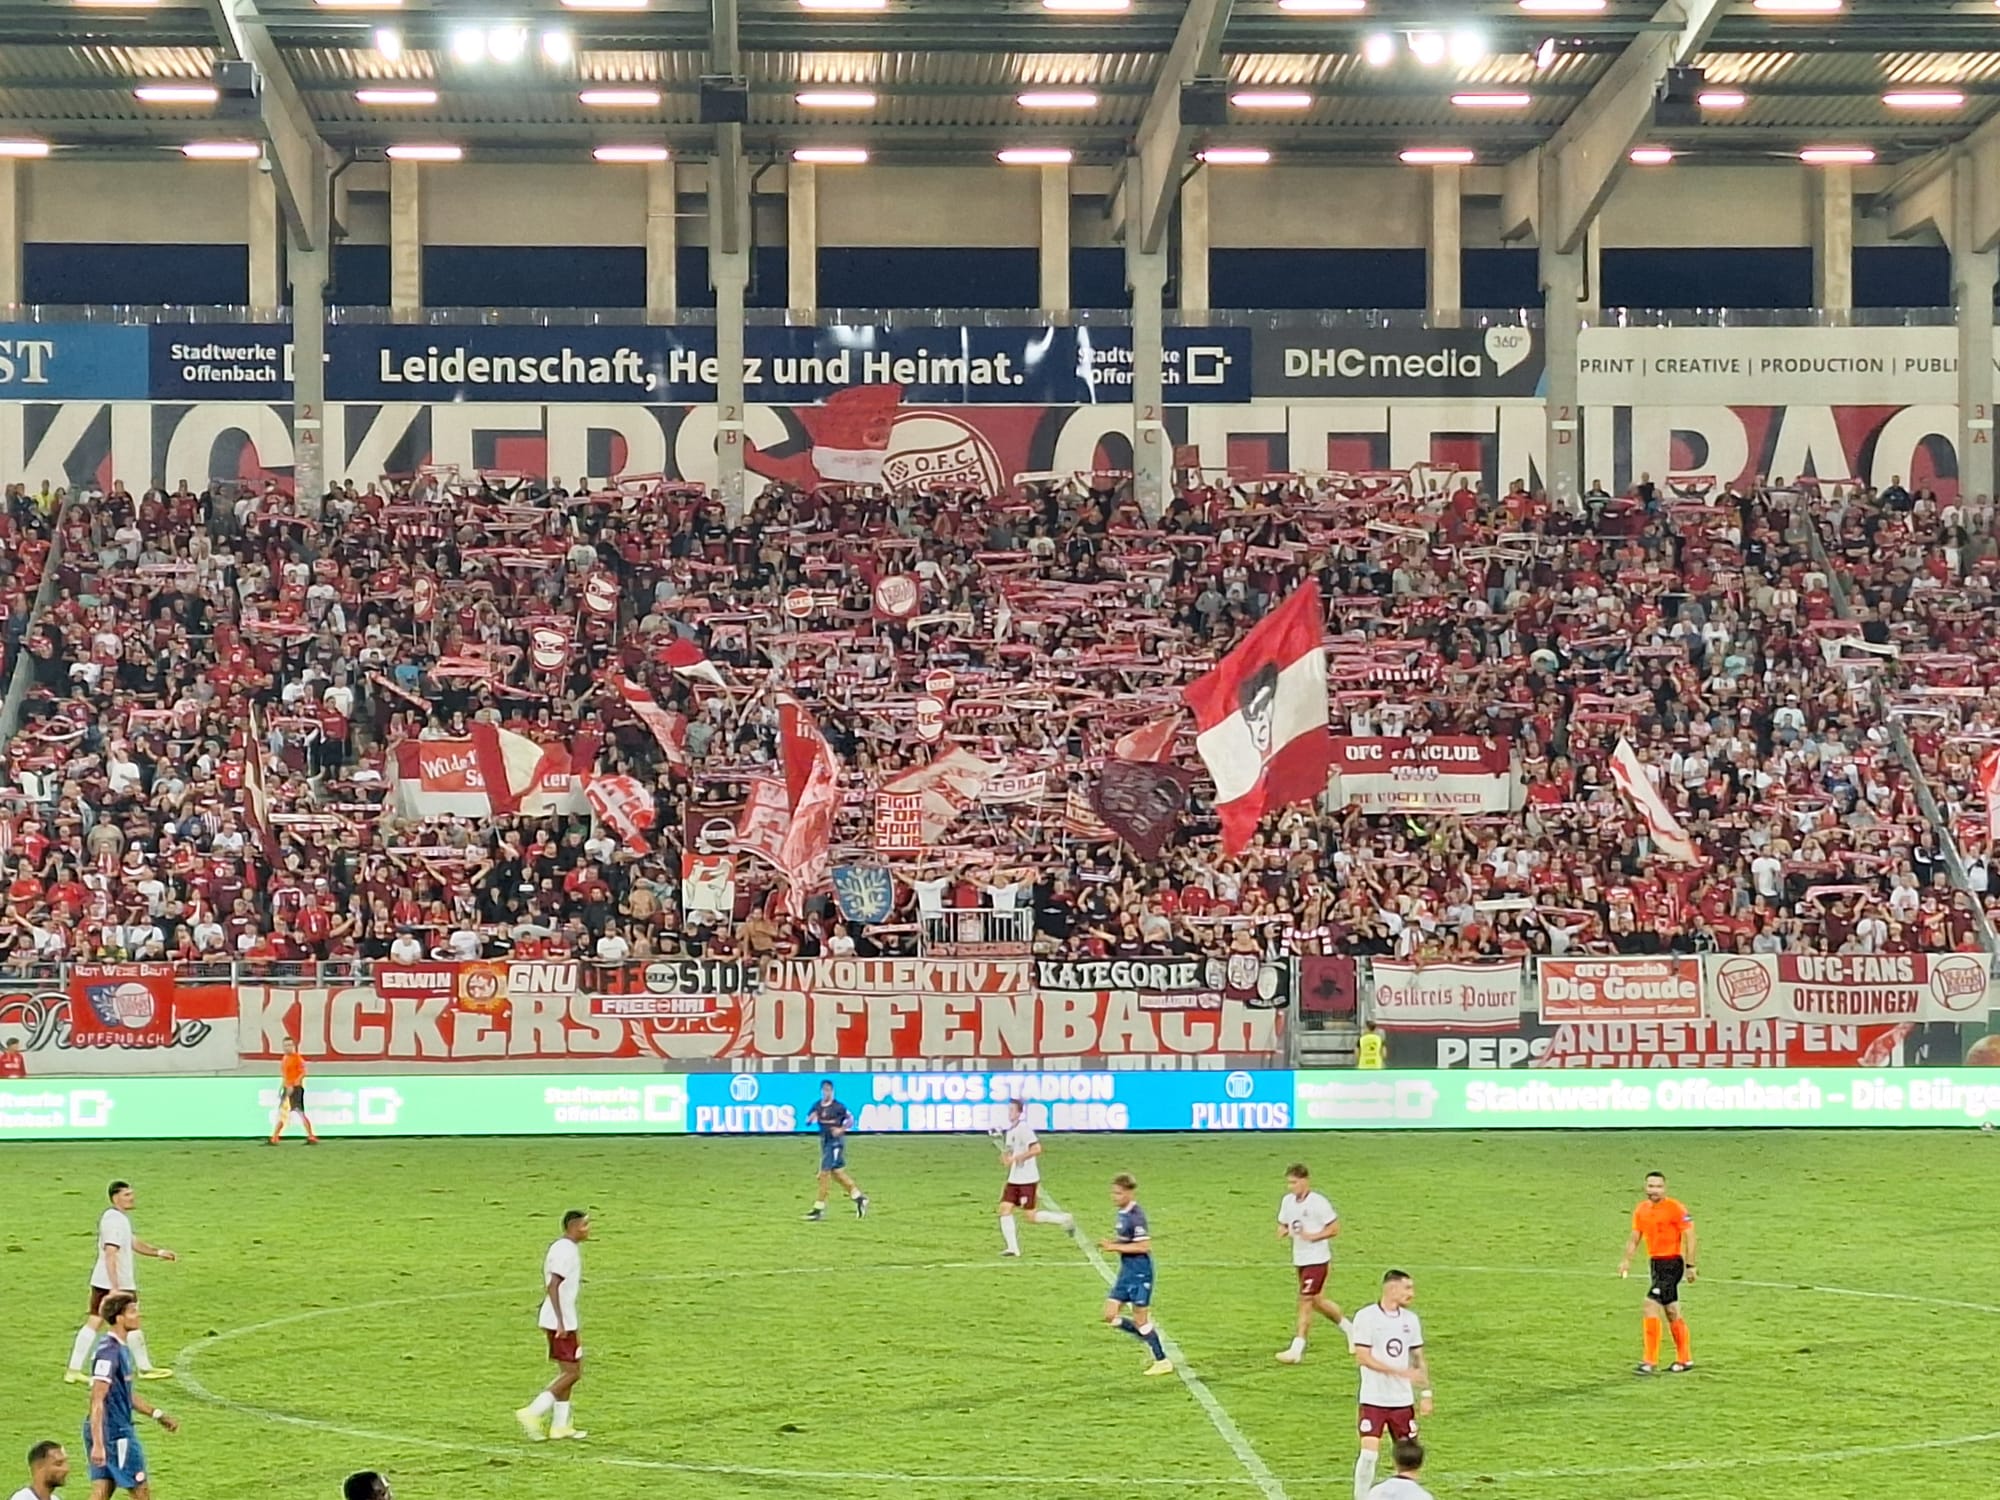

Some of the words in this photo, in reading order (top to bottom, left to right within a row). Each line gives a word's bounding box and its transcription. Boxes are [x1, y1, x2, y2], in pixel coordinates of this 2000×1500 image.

[171, 343, 277, 361] Stadtwerke
[182, 364, 276, 382] Offenbach
[380, 346, 657, 392] Leidenschaft,
[669, 349, 763, 384] Hez
[773, 349, 850, 384] und
[863, 348, 1024, 385] Heimat.
[1580, 358, 1635, 374] PRINT
[1654, 358, 1741, 374] CREATIVE
[1760, 358, 1884, 374] PRODUCTION
[303, 404, 312, 419] 2
[726, 405, 735, 419] 2
[1144, 405, 1154, 420] 2
[1559, 406, 1569, 419] 2
[1976, 405, 1985, 419] 3
[302, 430, 314, 444] A
[725, 430, 737, 444] B
[1143, 428, 1156, 444] C
[1558, 429, 1572, 444] D
[1973, 429, 1987, 444] A
[914, 449, 974, 472] O.F.C.
[1346, 745, 1382, 760] OFC
[876, 810, 922, 821] FOR
[876, 823, 922, 835] YOUR
[876, 836, 922, 848] CLUB
[508, 964, 578, 993] GNU
[996, 962, 1031, 991] 71
[1037, 960, 1200, 991] KATEGORIE
[1798, 957, 1915, 984] OFC-FANS
[381, 972, 451, 989] ERWIN
[1546, 976, 1597, 1001] Die
[1376, 984, 1452, 1007] Ostkreis
[1461, 984, 1517, 1011] Power
[1793, 988, 1920, 1013] OFTERDINGEN
[237, 985, 624, 1056] KICKERS
[754, 990, 1277, 1057] OFFENBACH
[76, 1032, 165, 1045] OFFENBACH
[872, 1074, 985, 1101] PLUTOS
[989, 1074, 1114, 1101] STADION
[1465, 1078, 1652, 1113] Stadtwerke
[1656, 1077, 1822, 1112] Offenbach
[1851, 1077, 1904, 1111] Die
[696, 1104, 796, 1132] PLUTOS
[858, 1103, 904, 1131] AM
[907, 1103, 1048, 1131] BIEBERR
[1052, 1103, 1130, 1131] BERG
[1191, 1102, 1290, 1130] PLUTOS
[1302, 1278, 1314, 1294] 7
